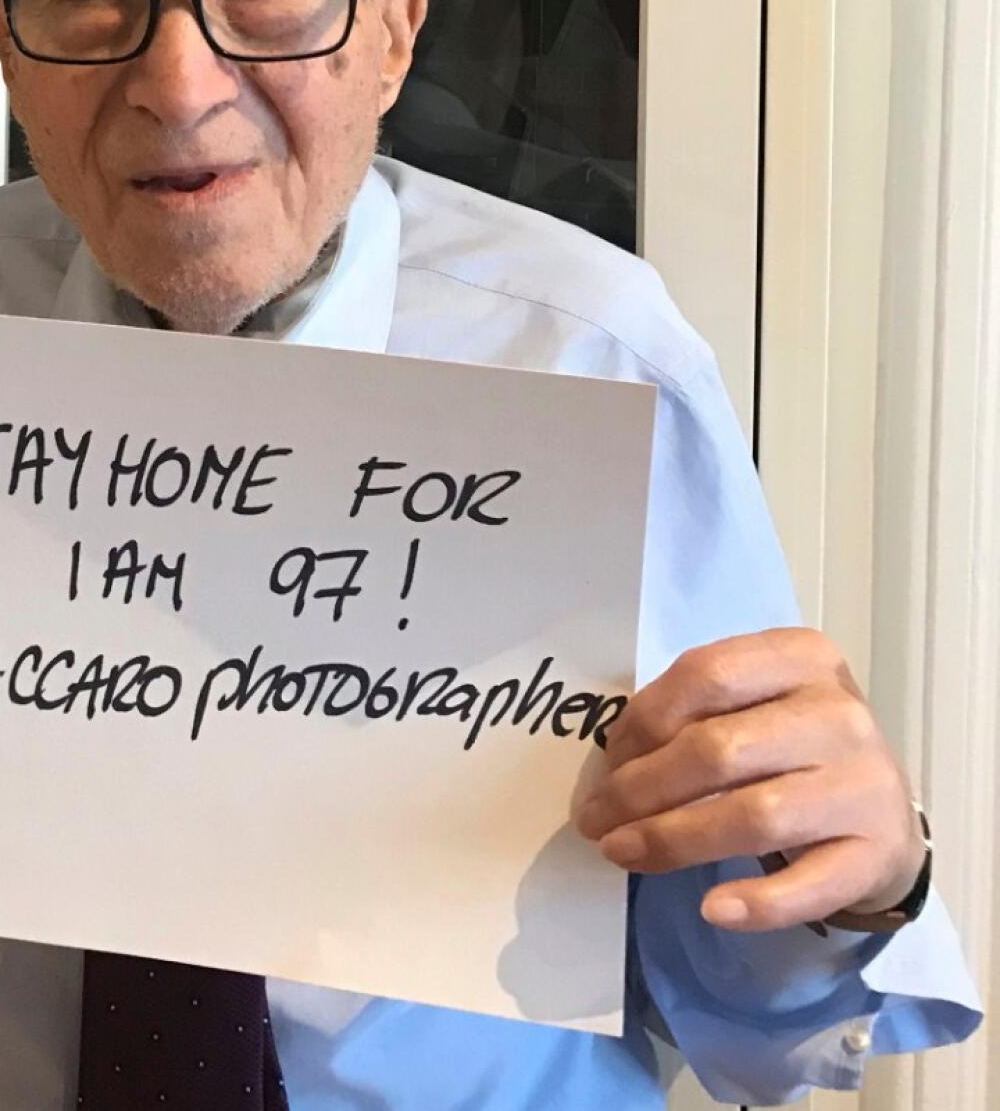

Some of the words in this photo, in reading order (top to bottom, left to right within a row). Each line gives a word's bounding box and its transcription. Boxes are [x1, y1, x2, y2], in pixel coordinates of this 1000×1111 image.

[348, 455, 523, 527] FOR
[68, 539, 82, 602] I
[101, 538, 187, 612] AM
